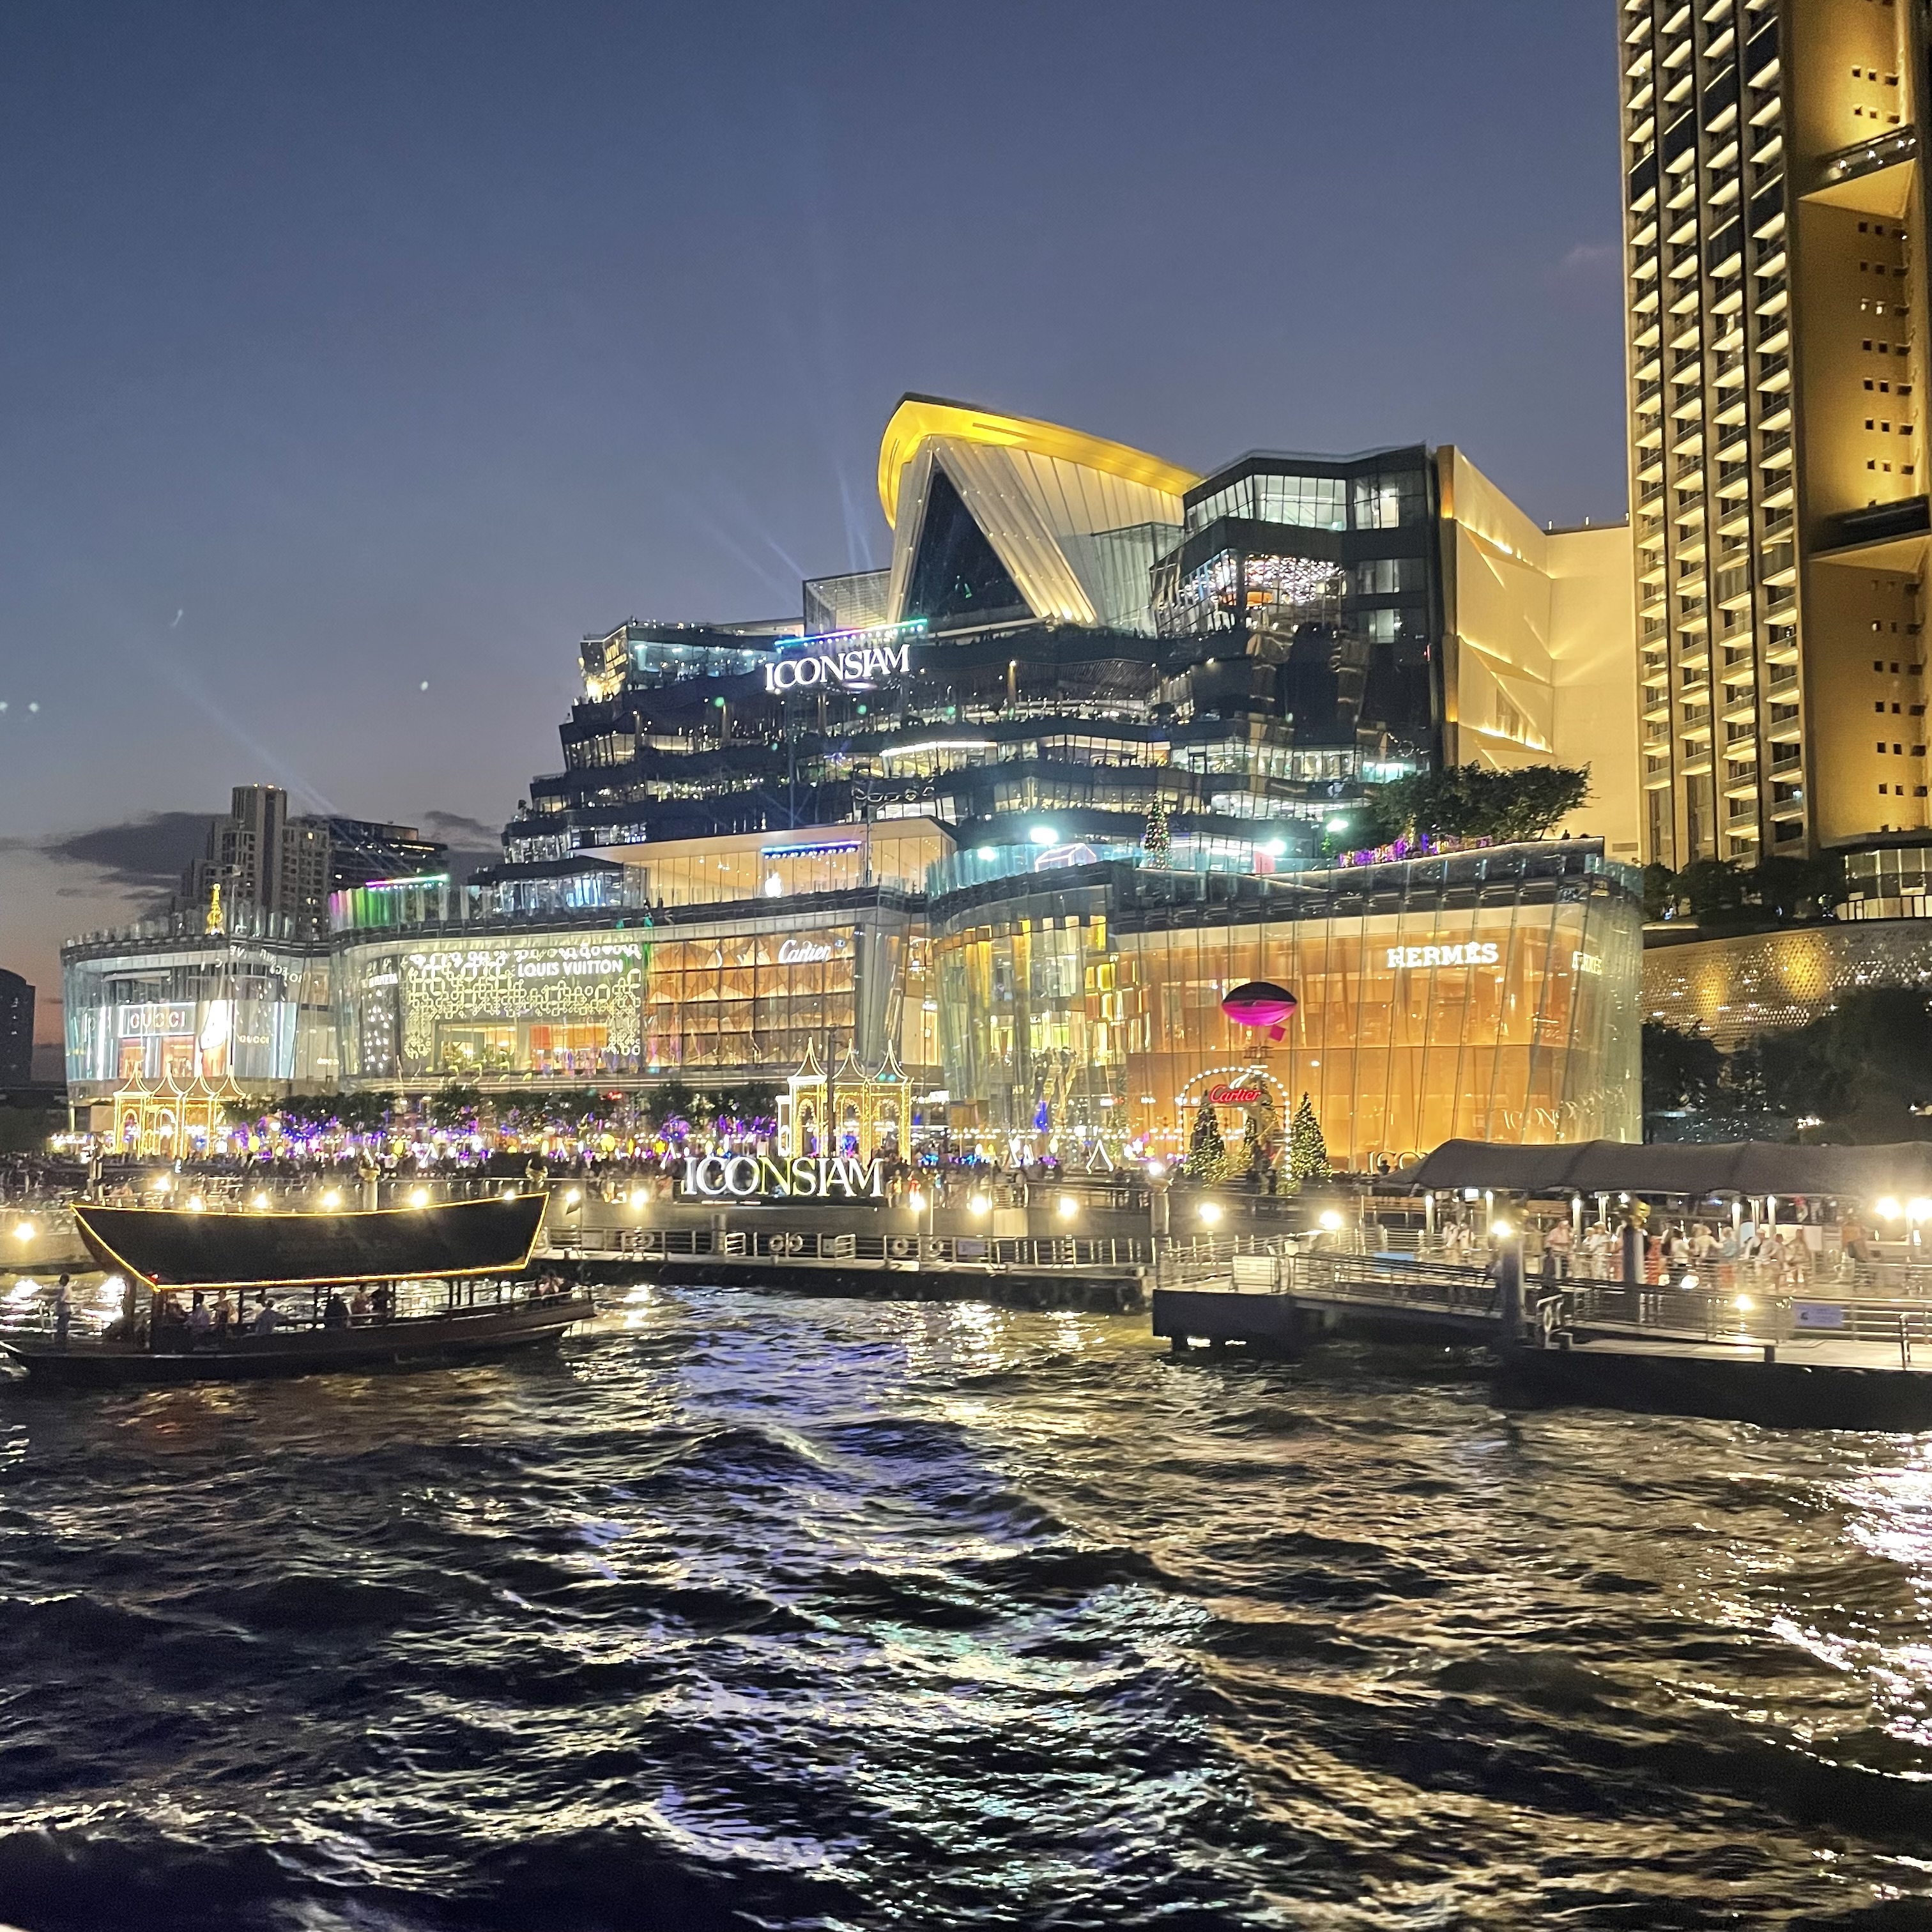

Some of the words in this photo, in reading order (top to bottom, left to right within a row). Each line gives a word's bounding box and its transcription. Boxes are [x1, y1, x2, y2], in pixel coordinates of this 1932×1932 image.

[765, 644, 910, 691] ICONSIAM
[778, 939, 831, 963] Cartier
[518, 962, 560, 977] LOUIS
[563, 959, 624, 976] VUITTON
[130, 1011, 186, 1029] GUCCI
[1209, 1084, 1262, 1104] Cartier
[682, 1156, 884, 1197] ICONSIAM
